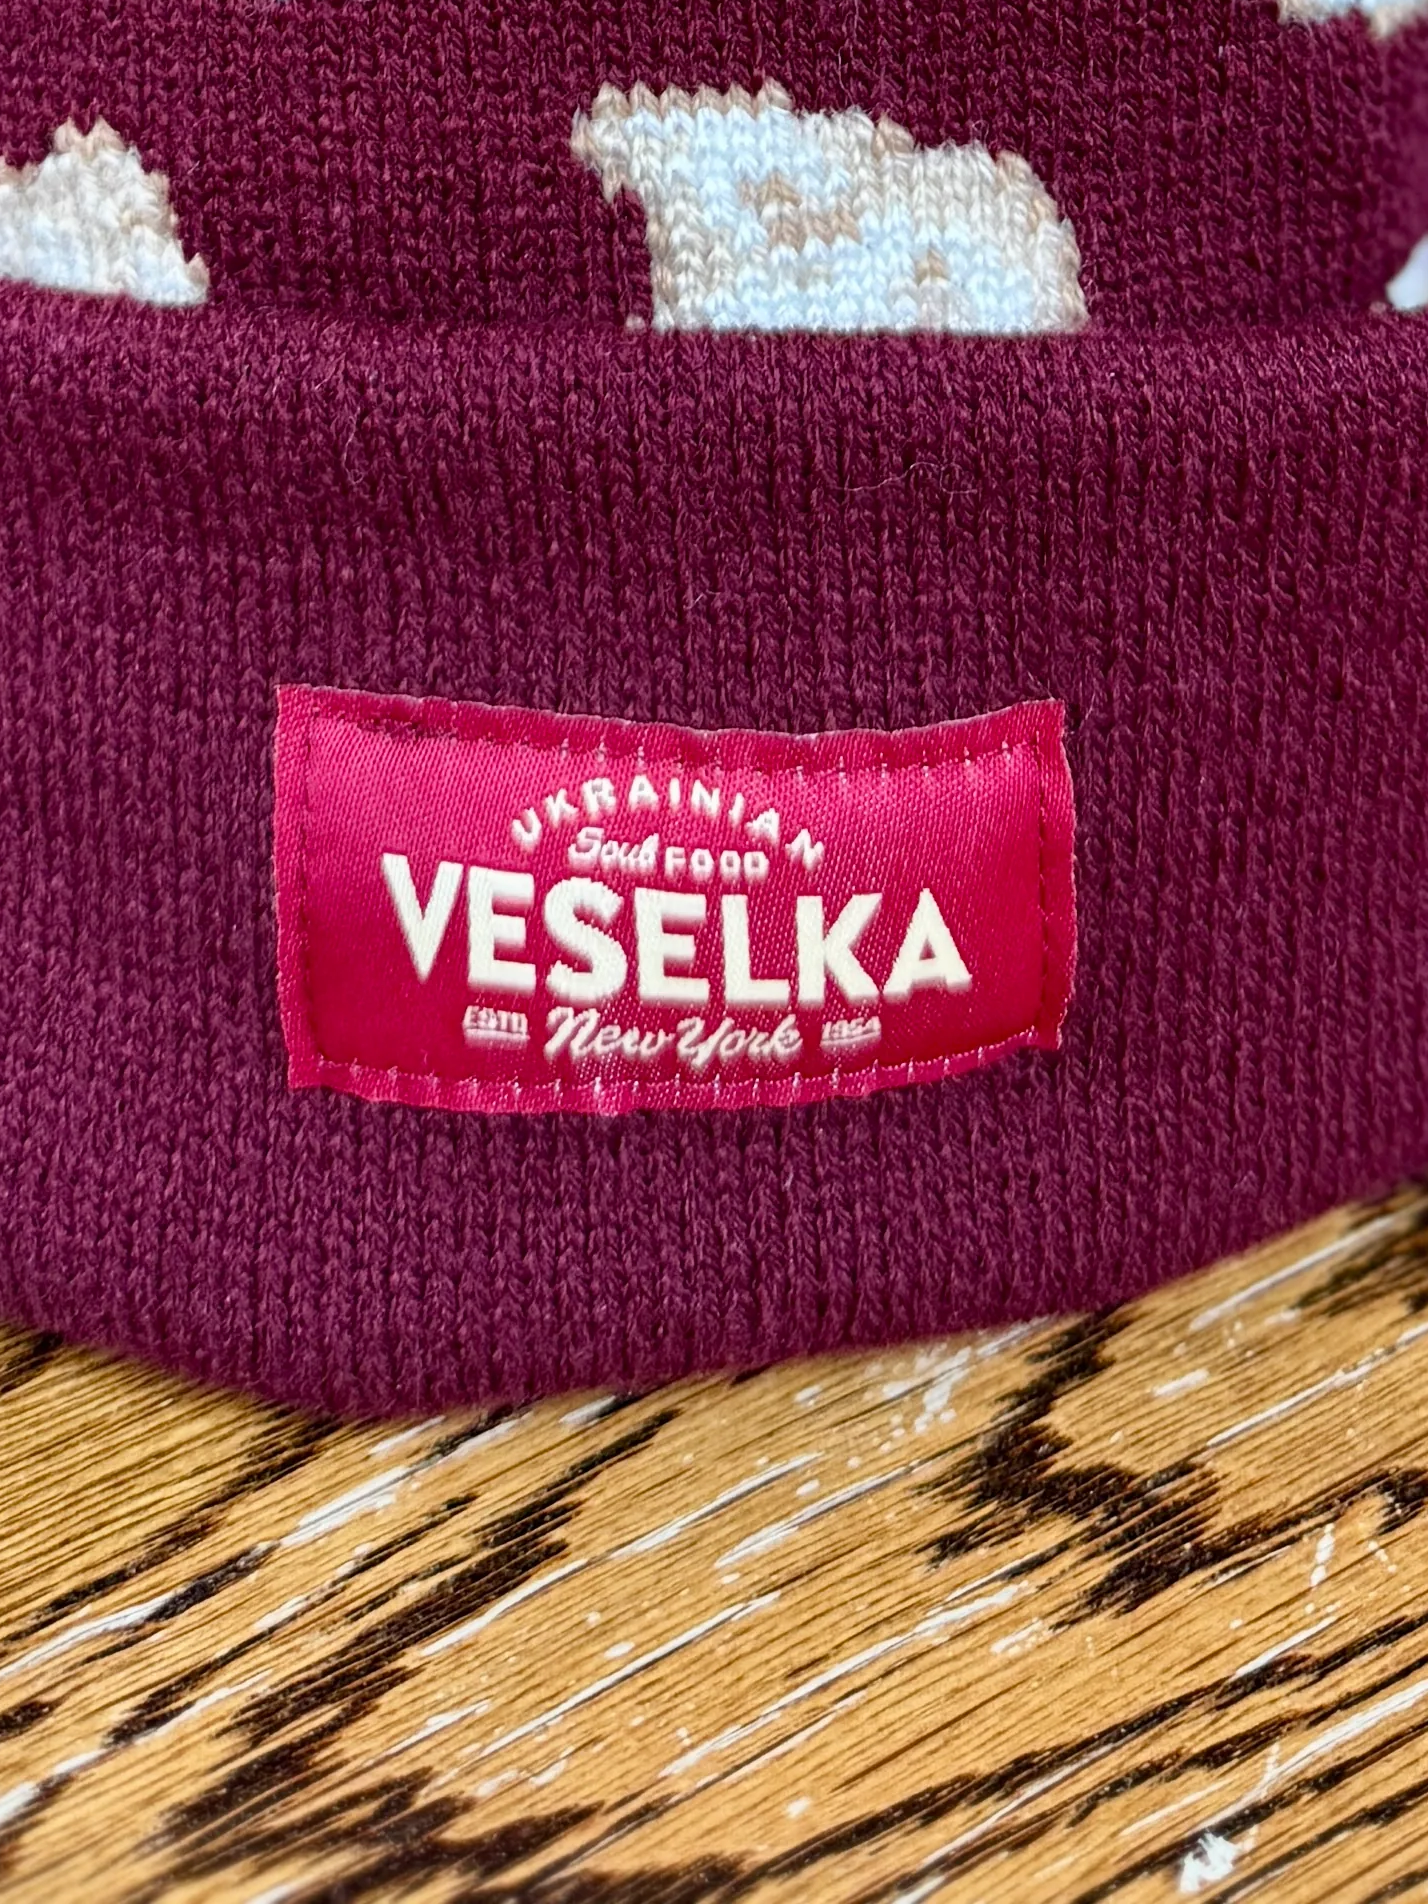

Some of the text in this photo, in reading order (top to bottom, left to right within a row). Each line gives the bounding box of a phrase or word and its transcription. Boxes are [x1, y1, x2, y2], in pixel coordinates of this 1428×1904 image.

[511, 775, 824, 870] UKRAINIAN
[568, 826, 770, 882] Soul FOOD
[380, 853, 972, 1006] VESELKA
[544, 1006, 672, 1059] New
[676, 1014, 804, 1068] York
